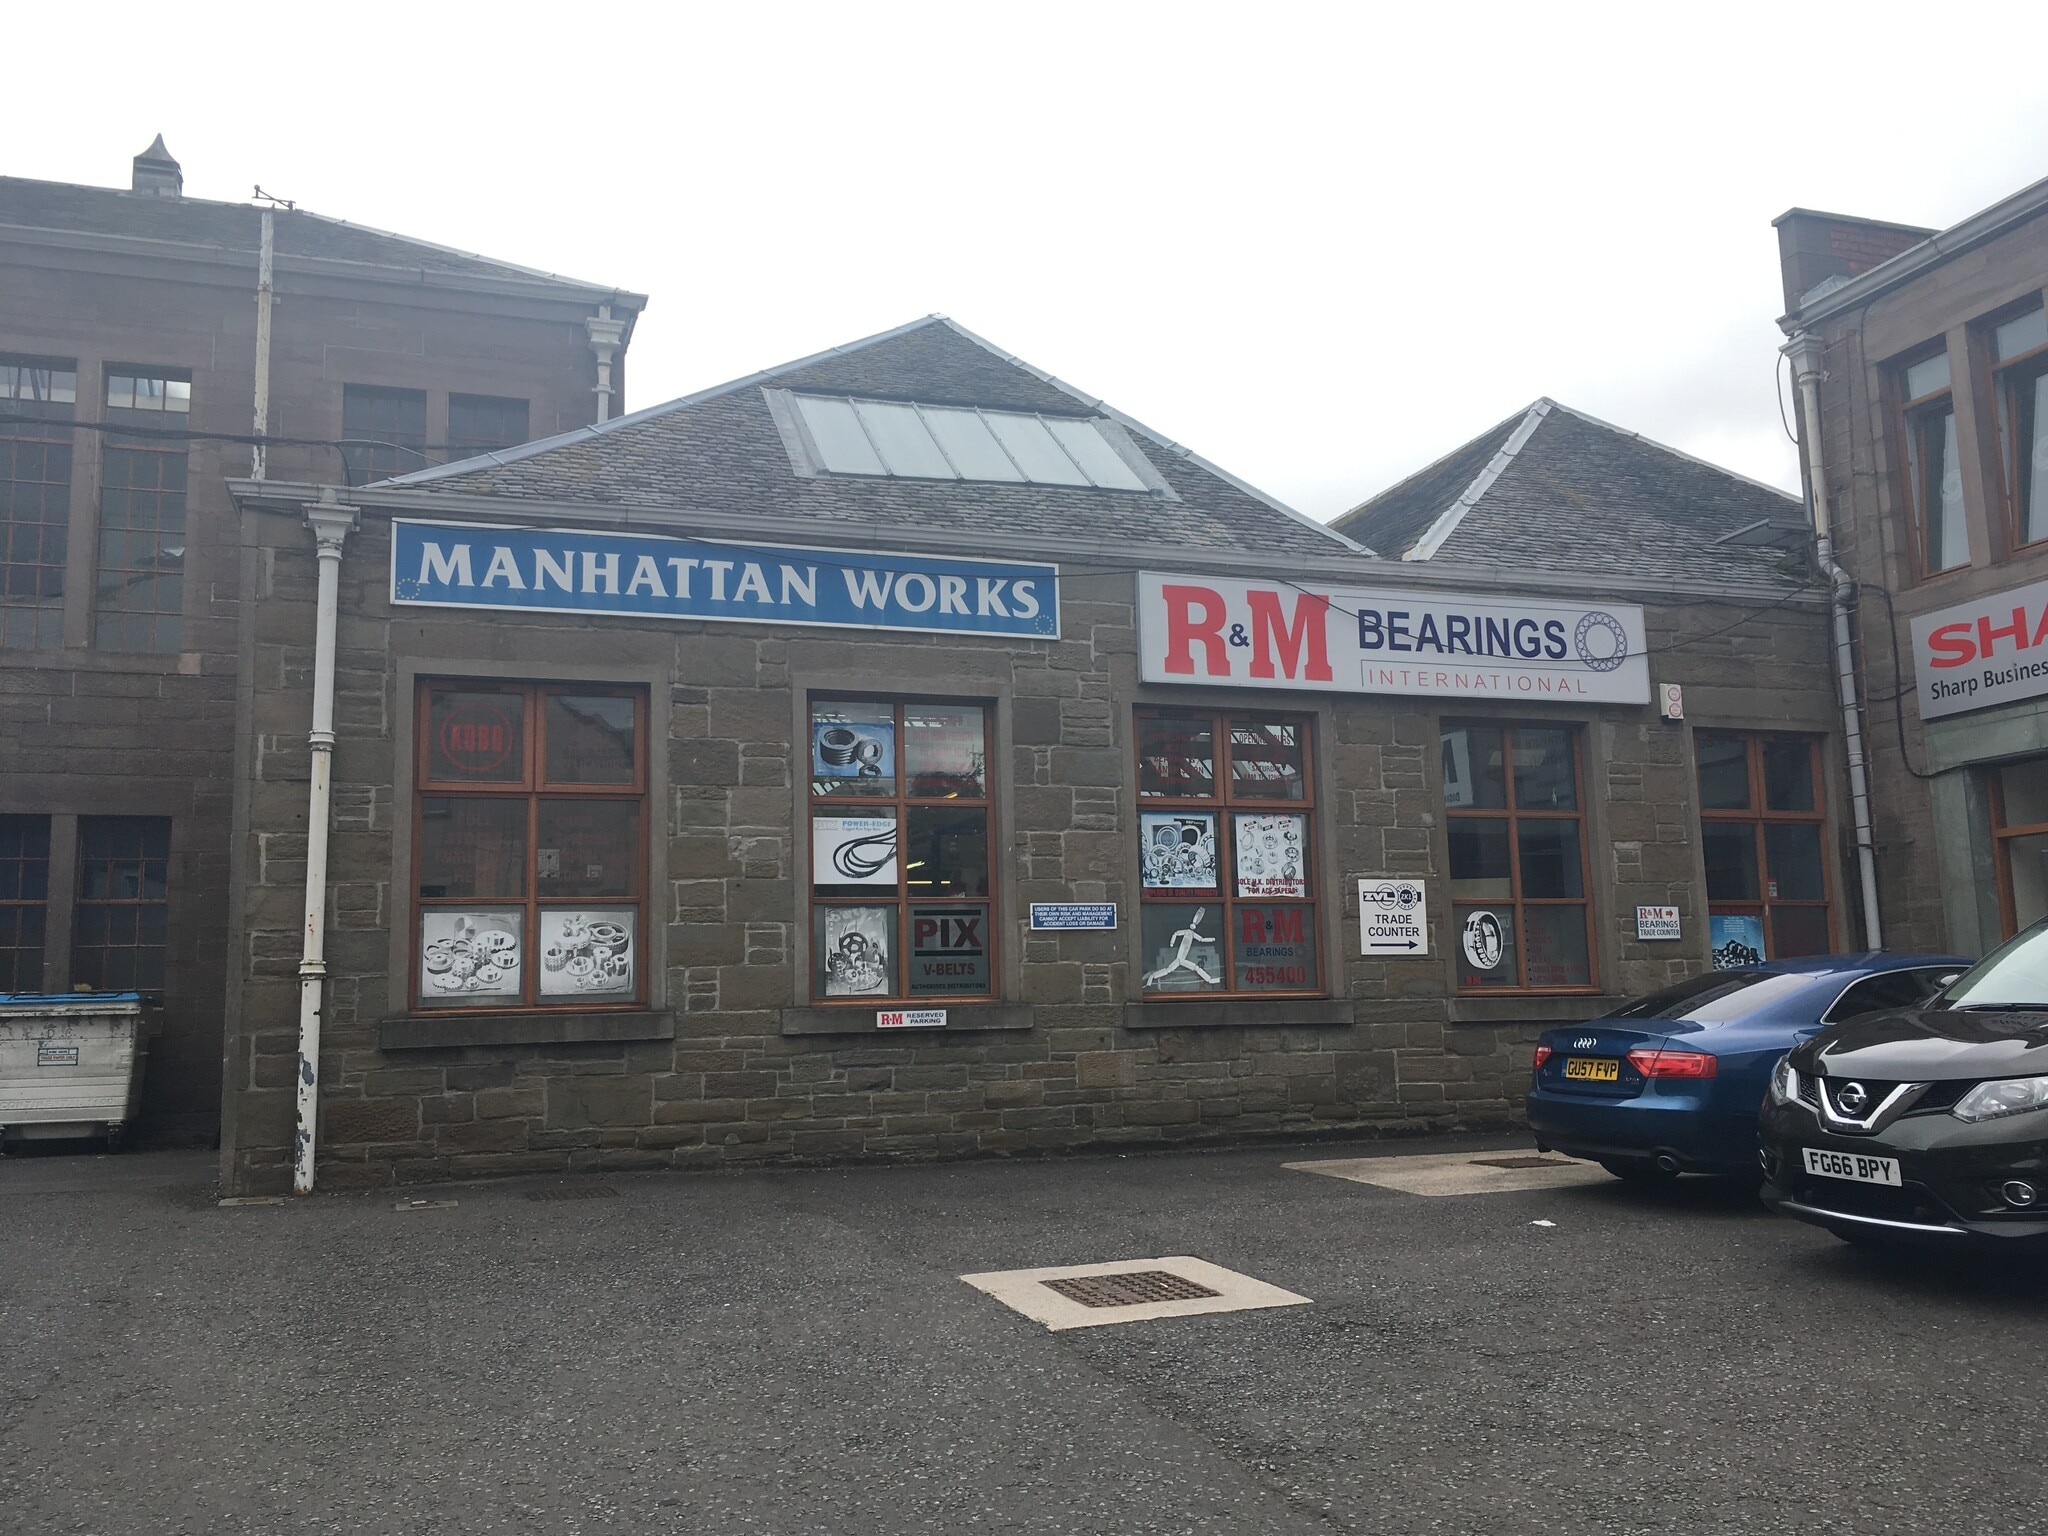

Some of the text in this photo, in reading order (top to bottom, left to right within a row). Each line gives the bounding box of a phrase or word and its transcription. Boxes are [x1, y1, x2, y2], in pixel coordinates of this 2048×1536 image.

[418, 541, 1040, 620] MANHATTAN WORKS
[1162, 584, 1568, 682] R&M BEARINGS
[1368, 668, 1588, 694] INTERNATIONAL
[1931, 677, 1978, 700] Sharp
[1364, 892, 1396, 901] ZVL
[1375, 914, 1412, 924] TRADE
[1639, 908, 1663, 919] R&M
[1241, 909, 1305, 943] R&M
[1368, 926, 1420, 937] COUNTER
[1640, 920, 1678, 928] BEARINGS
[914, 919, 982, 948] PIX
[1246, 947, 1294, 957] BEARINGS
[923, 963, 976, 976] V-BELTS
[1245, 966, 1306, 984] 455400
[1596, 1061, 1618, 1078] FVP
[1809, 1151, 1891, 1181] FG66 BPY
